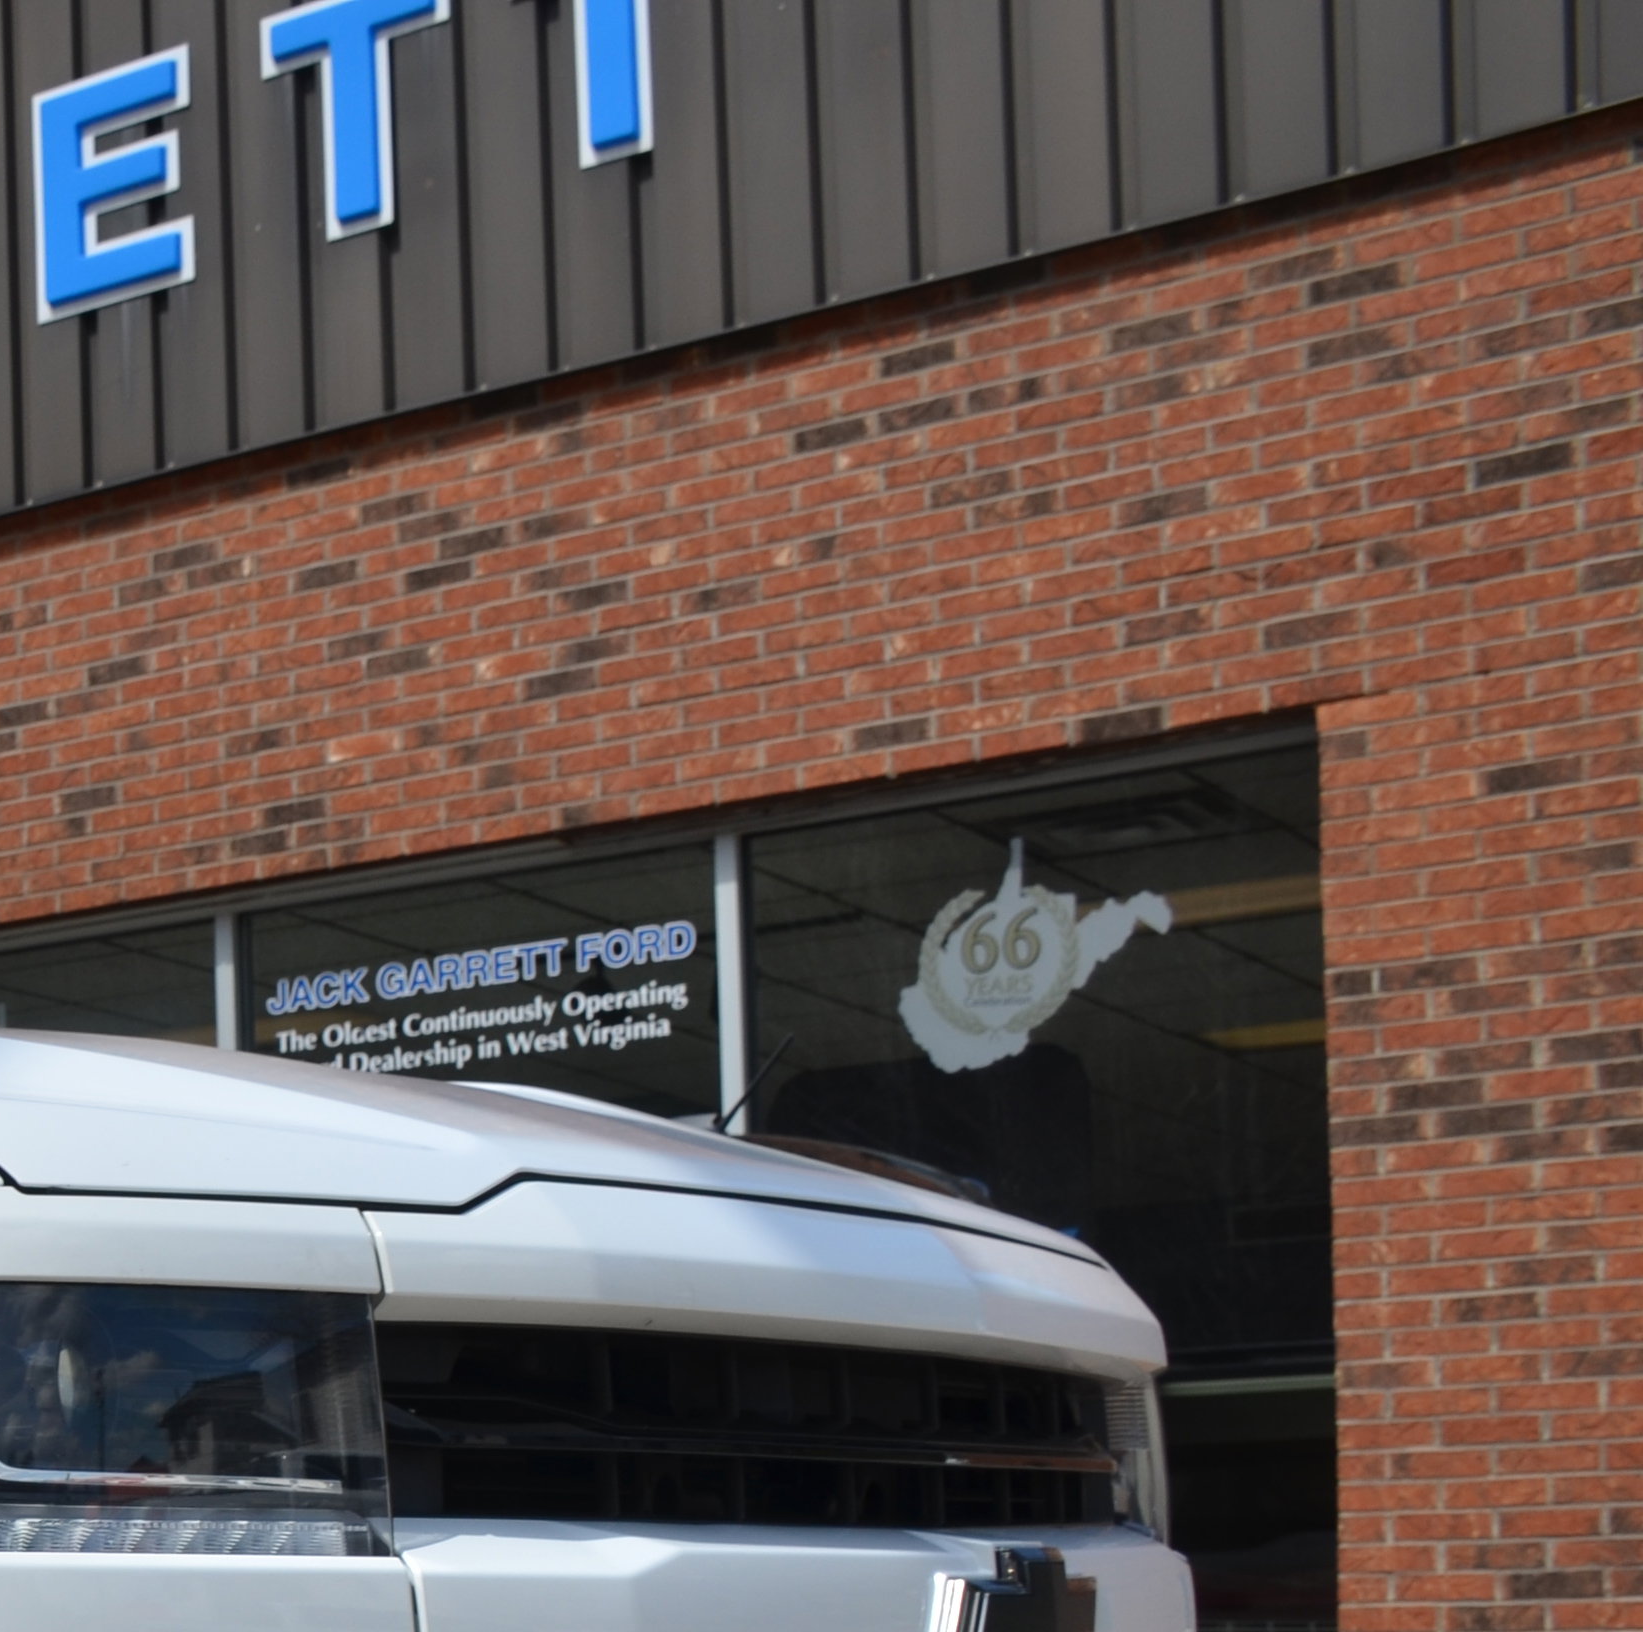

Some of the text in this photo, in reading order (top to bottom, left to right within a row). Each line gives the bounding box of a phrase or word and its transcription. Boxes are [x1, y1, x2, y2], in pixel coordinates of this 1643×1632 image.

[266, 919, 697, 1016] JACK GARRETT FORD
[961, 906, 1042, 975] 66
[276, 979, 689, 1055] The Oldest Continuously Operating
[349, 1038, 472, 1074] Dealership
[477, 1034, 502, 1061] in
[507, 1023, 569, 1056] West
[573, 1014, 672, 1051] Virginia
